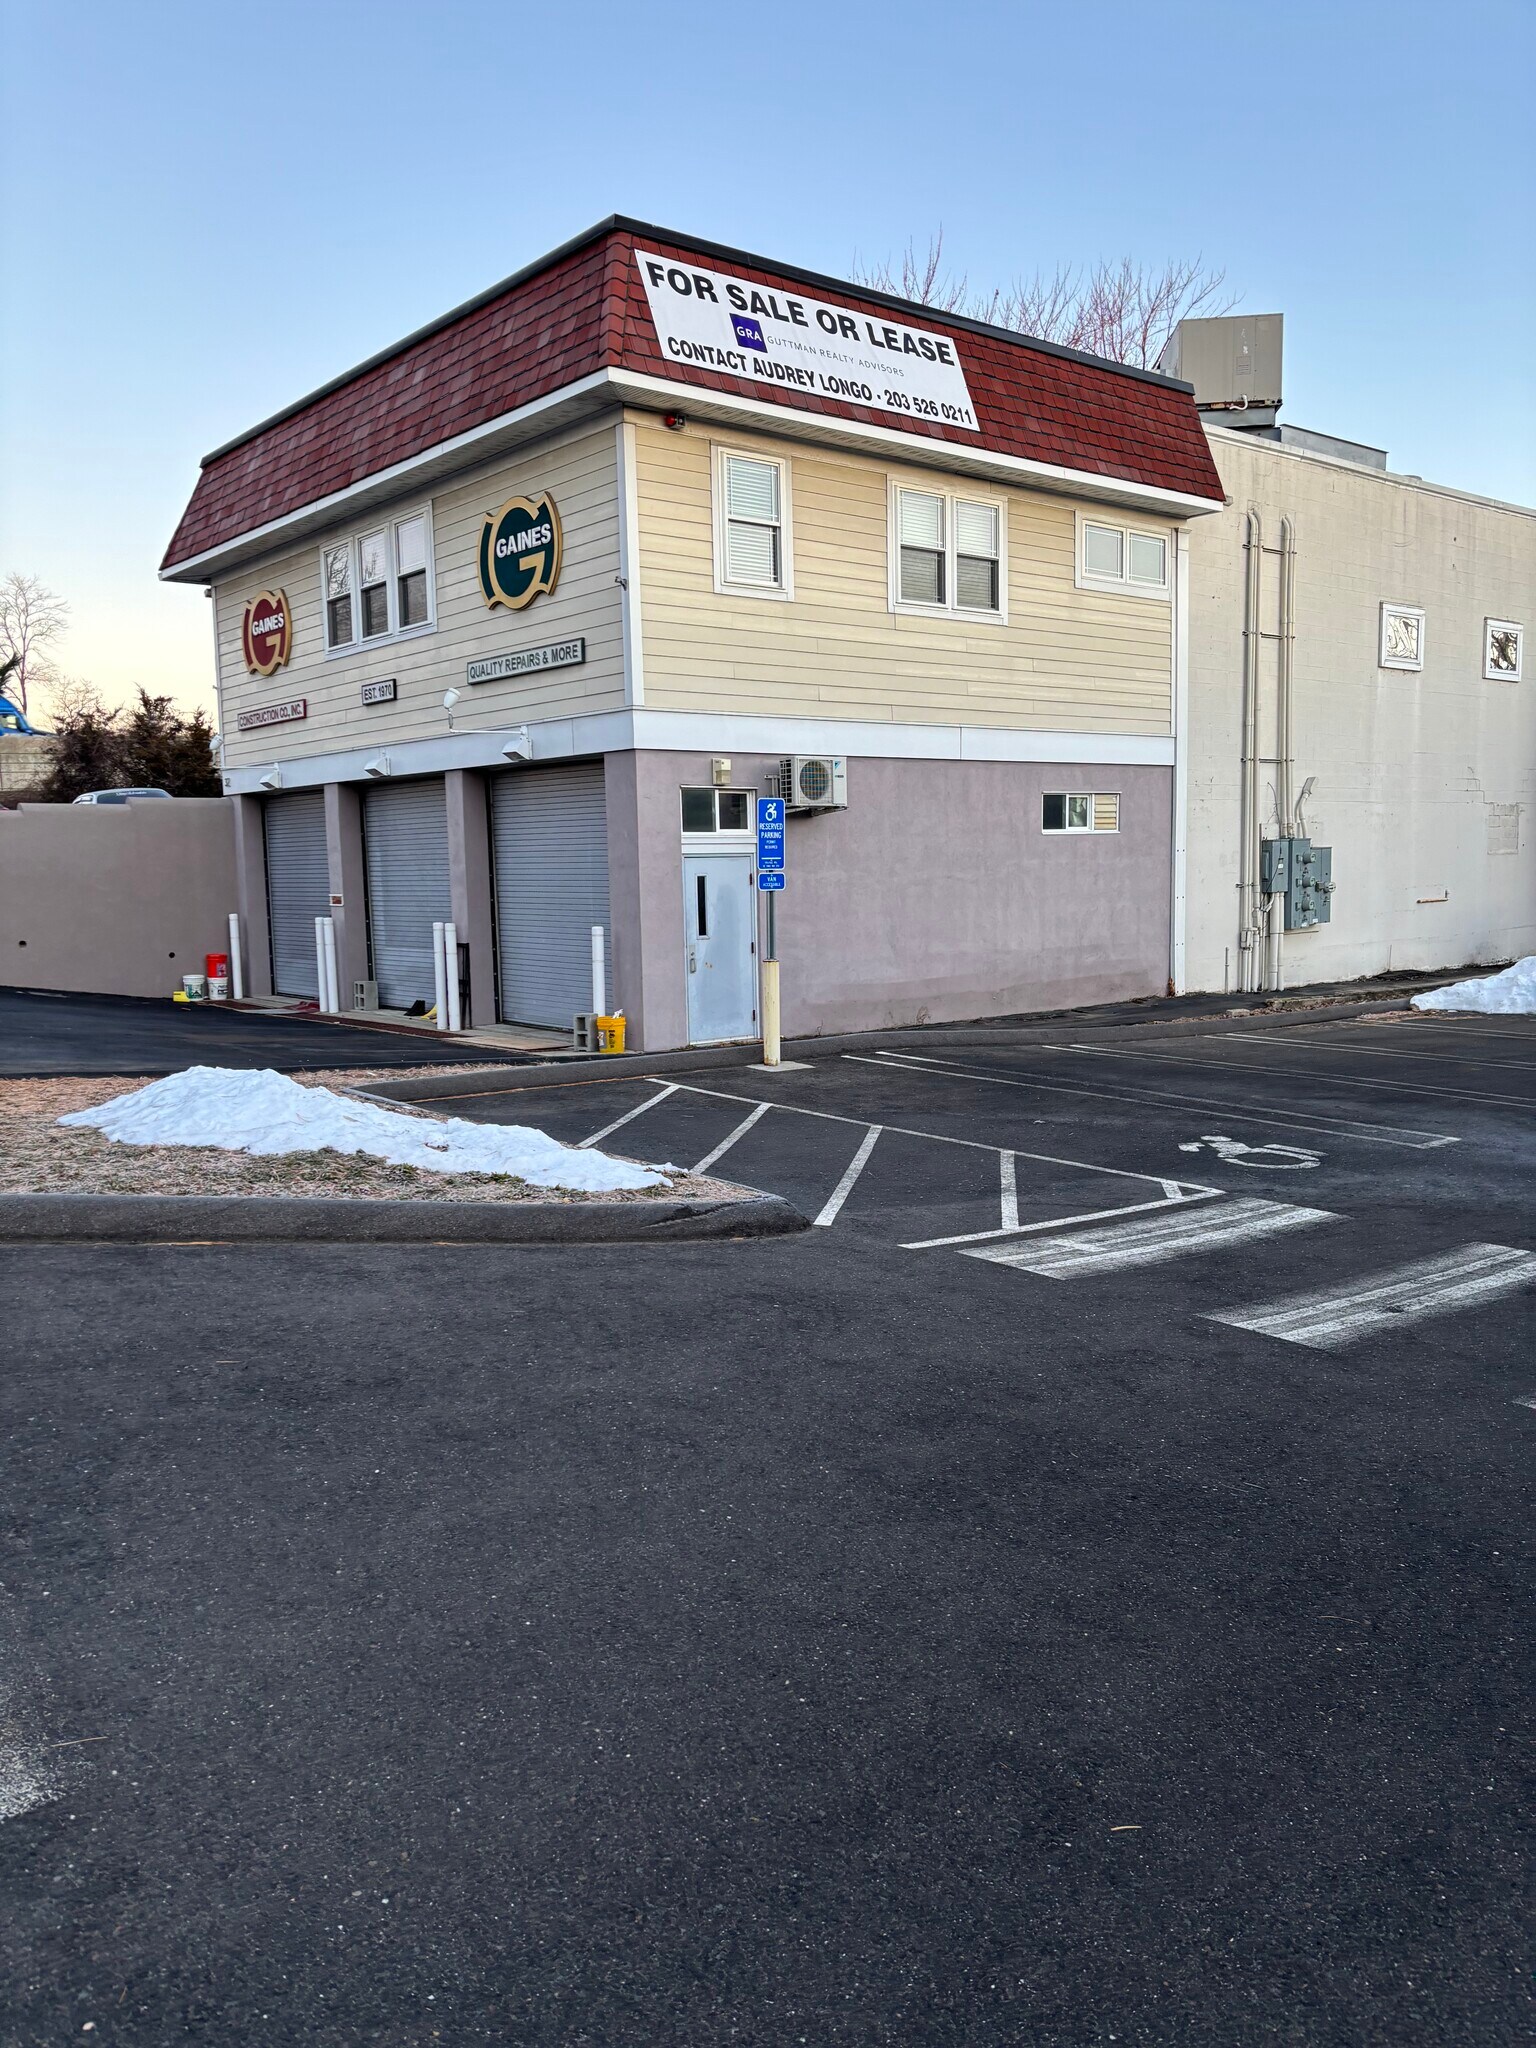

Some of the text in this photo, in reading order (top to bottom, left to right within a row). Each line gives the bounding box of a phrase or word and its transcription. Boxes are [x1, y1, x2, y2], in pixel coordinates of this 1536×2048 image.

[645, 261, 955, 366] FOR SALE OR LEASE
[736, 326, 762, 342] GRA
[767, 335, 905, 377] GUTTMAN REALTY ADVISORS
[667, 336, 973, 424] CONTACT AUDREY LONGO 203 526 0211
[496, 523, 552, 558] GAINES
[252, 612, 284, 636] GAINES
[469, 644, 579, 679] QUALITY REPAIRS & MORE
[364, 684, 392, 701] EST. 1970
[240, 708, 280, 727] CONSTRUCTION
[291, 703, 302, 716] INC.
